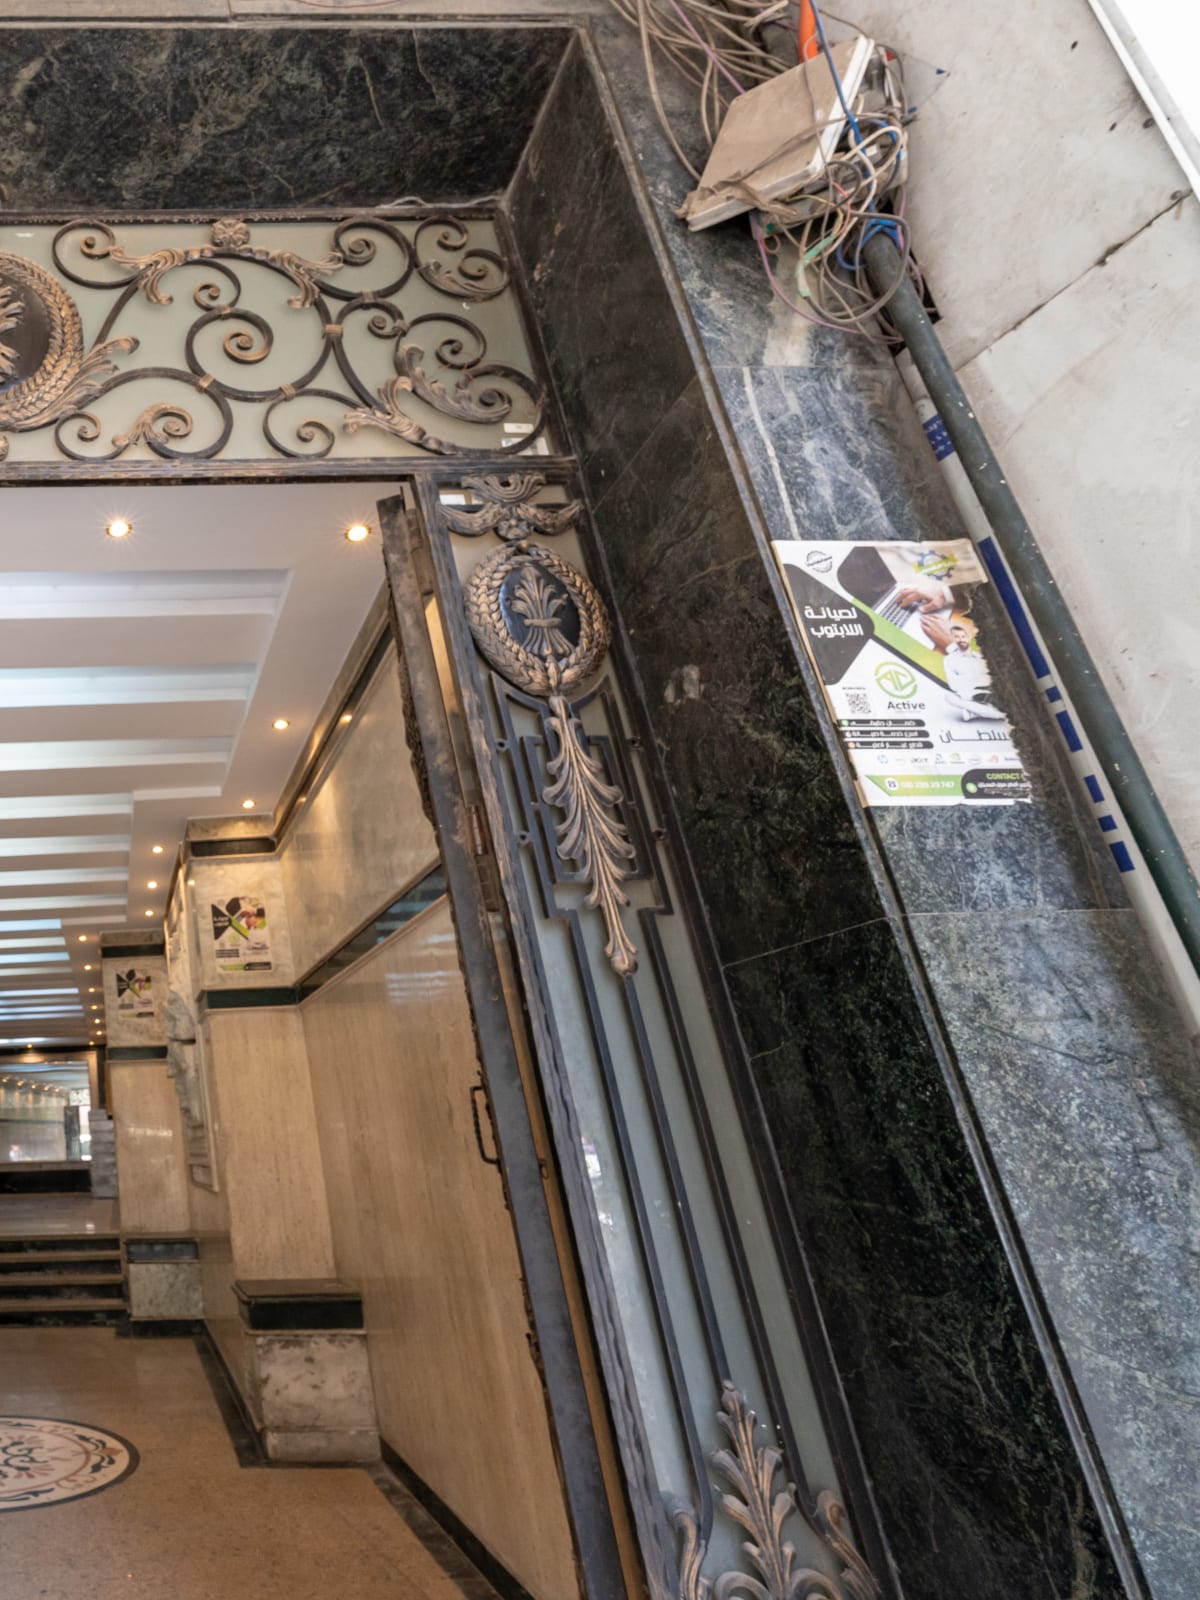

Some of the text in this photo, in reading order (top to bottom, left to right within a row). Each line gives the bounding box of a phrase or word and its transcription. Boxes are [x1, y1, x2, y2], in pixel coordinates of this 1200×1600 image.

[804, 605, 858, 621] لصيانة
[810, 622, 864, 638] اللابتوب
[887, 701, 927, 710] Active
[985, 772, 1020, 780] CONTACT
